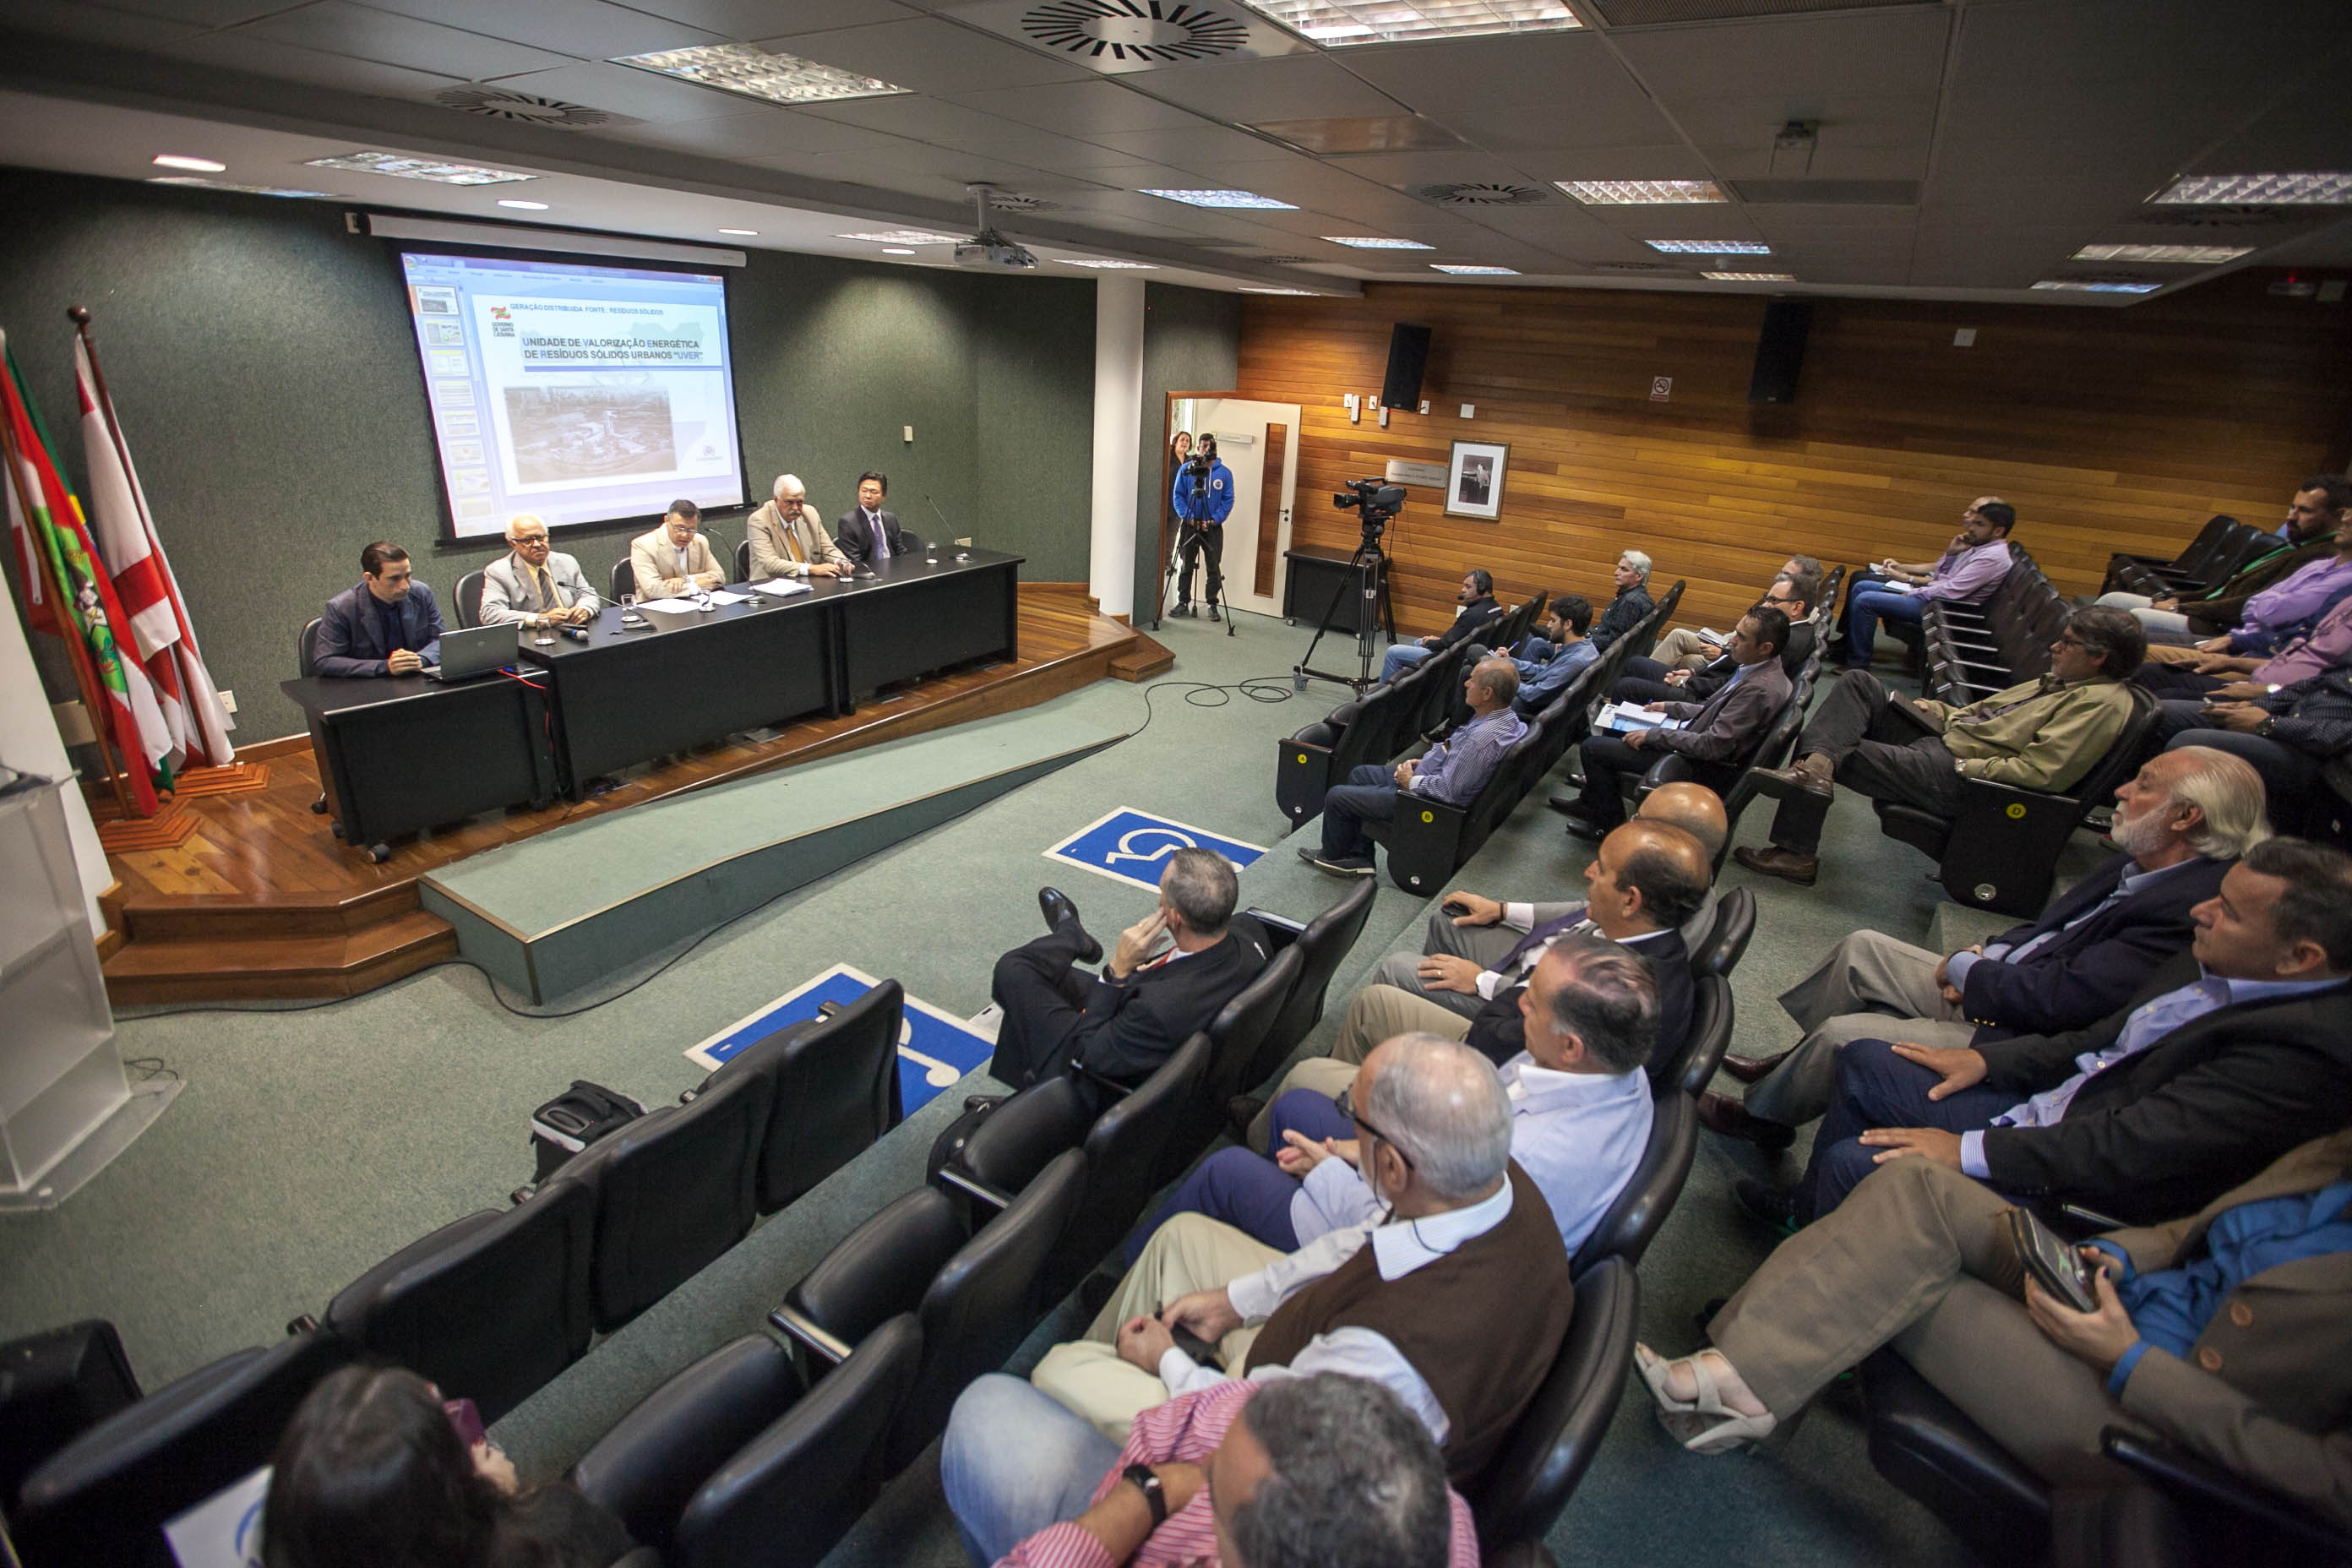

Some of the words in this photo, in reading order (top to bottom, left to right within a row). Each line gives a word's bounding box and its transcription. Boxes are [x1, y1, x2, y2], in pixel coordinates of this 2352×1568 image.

[510, 303, 543, 312] GERAÇÃO
[522, 337, 566, 346] UNIDADE
[568, 338, 581, 346] DE
[583, 338, 645, 349] VALORIZAÇÃO
[647, 339, 700, 348] ENERGÉTICA
[525, 350, 539, 358] DE
[541, 348, 589, 358] RESÍDUOS
[591, 349, 629, 359] SÓLIDOS
[631, 351, 672, 359] URBANOS
